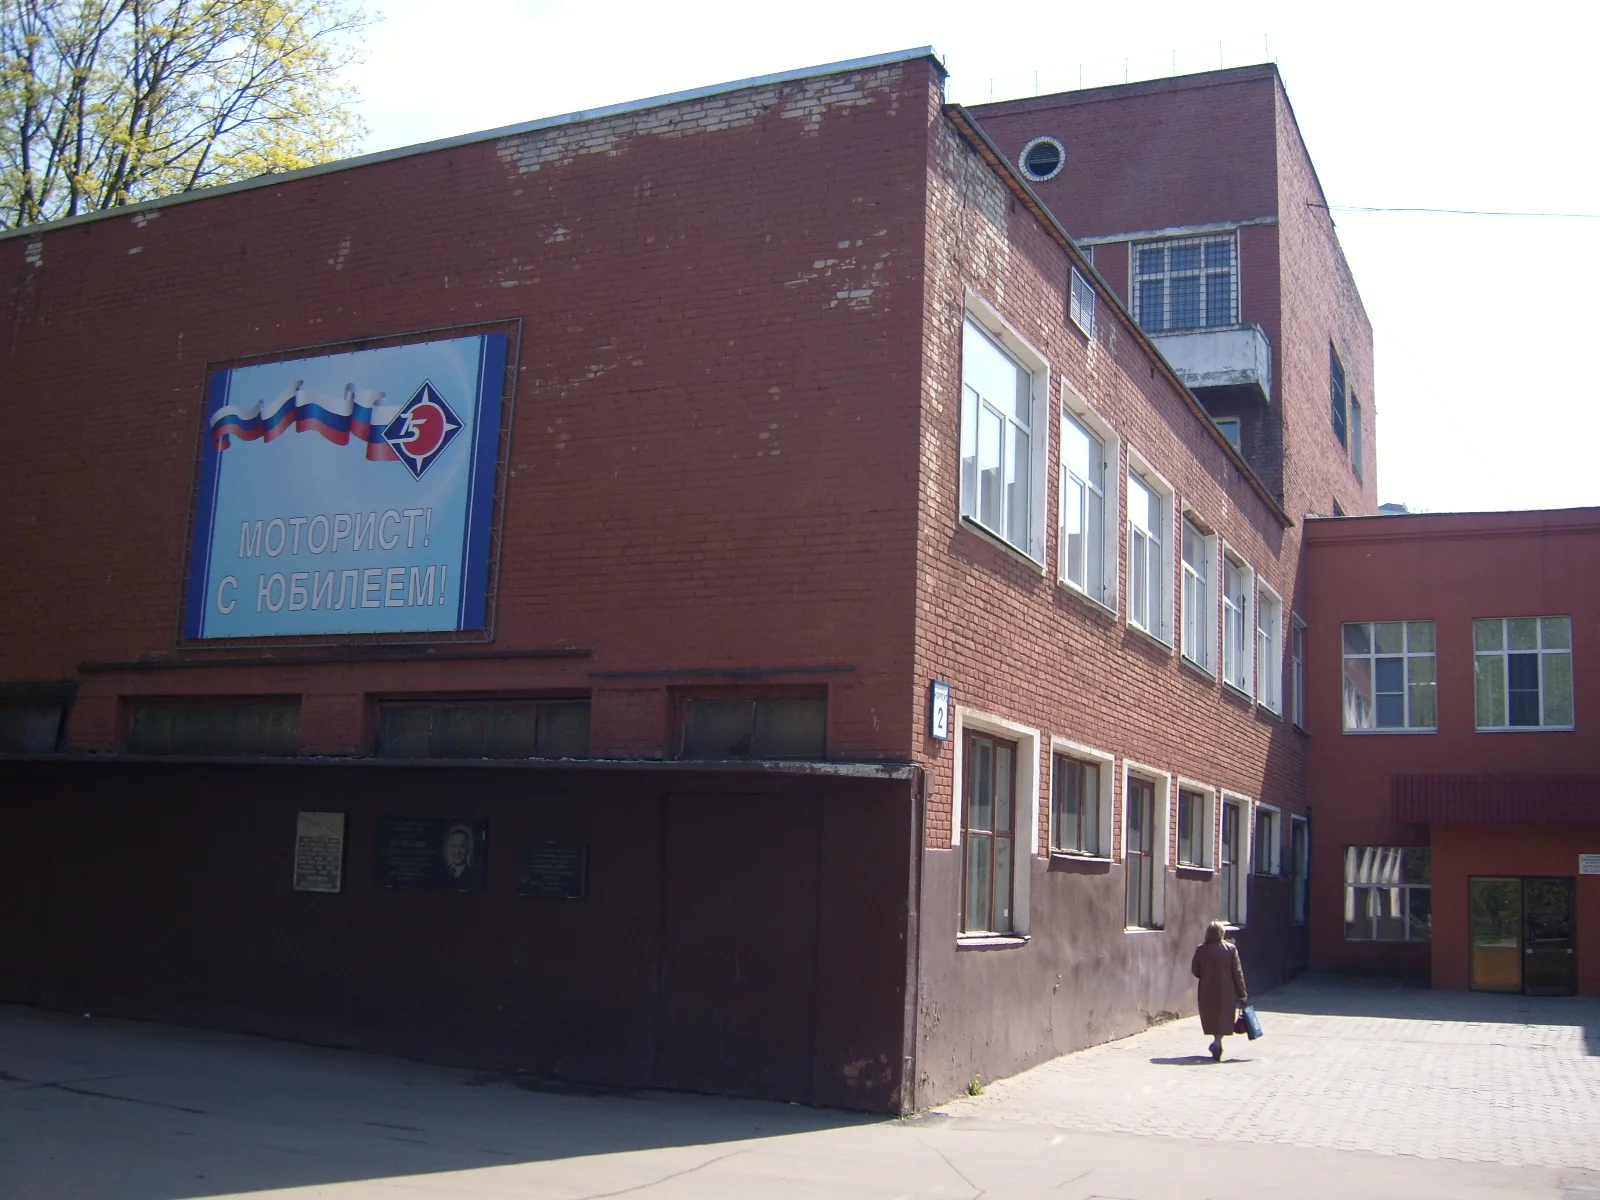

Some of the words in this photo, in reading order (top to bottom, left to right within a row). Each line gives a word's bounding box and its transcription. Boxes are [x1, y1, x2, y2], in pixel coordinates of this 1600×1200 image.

[238, 508, 432, 558] МОТОРИСТ!
[217, 575, 239, 615] С
[256, 565, 448, 613] ЮБИЛЕЕМ!
[938, 707, 944, 729] 2
